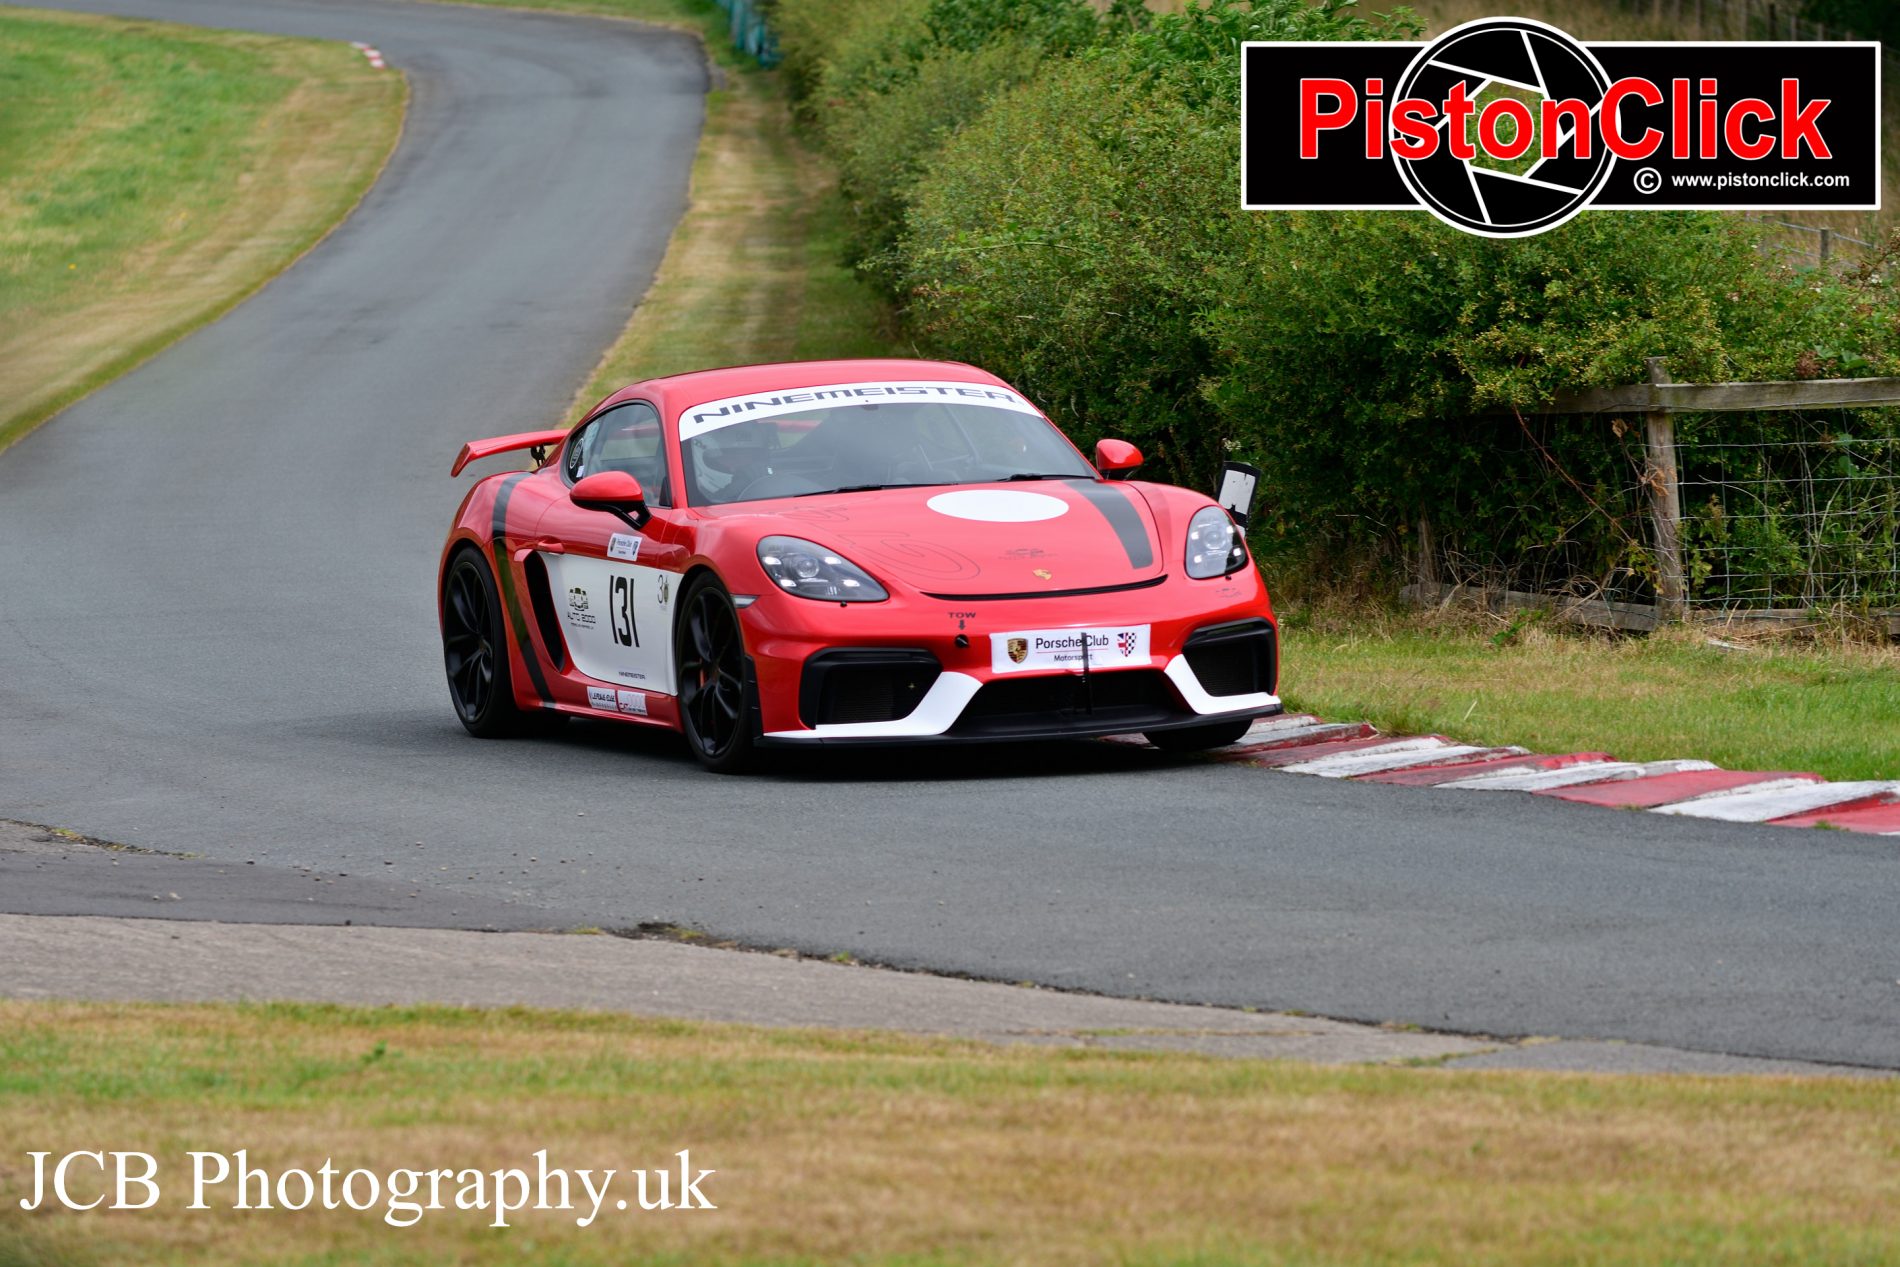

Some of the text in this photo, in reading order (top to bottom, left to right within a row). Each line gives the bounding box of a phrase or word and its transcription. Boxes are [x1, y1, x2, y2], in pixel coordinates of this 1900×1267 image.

[693, 385, 1017, 424] NINEMEISTER
[609, 575, 640, 648] 131
[948, 611, 976, 619] TOW
[1035, 634, 1109, 649] Porsche Club
[1054, 654, 1093, 662] Motorspt
